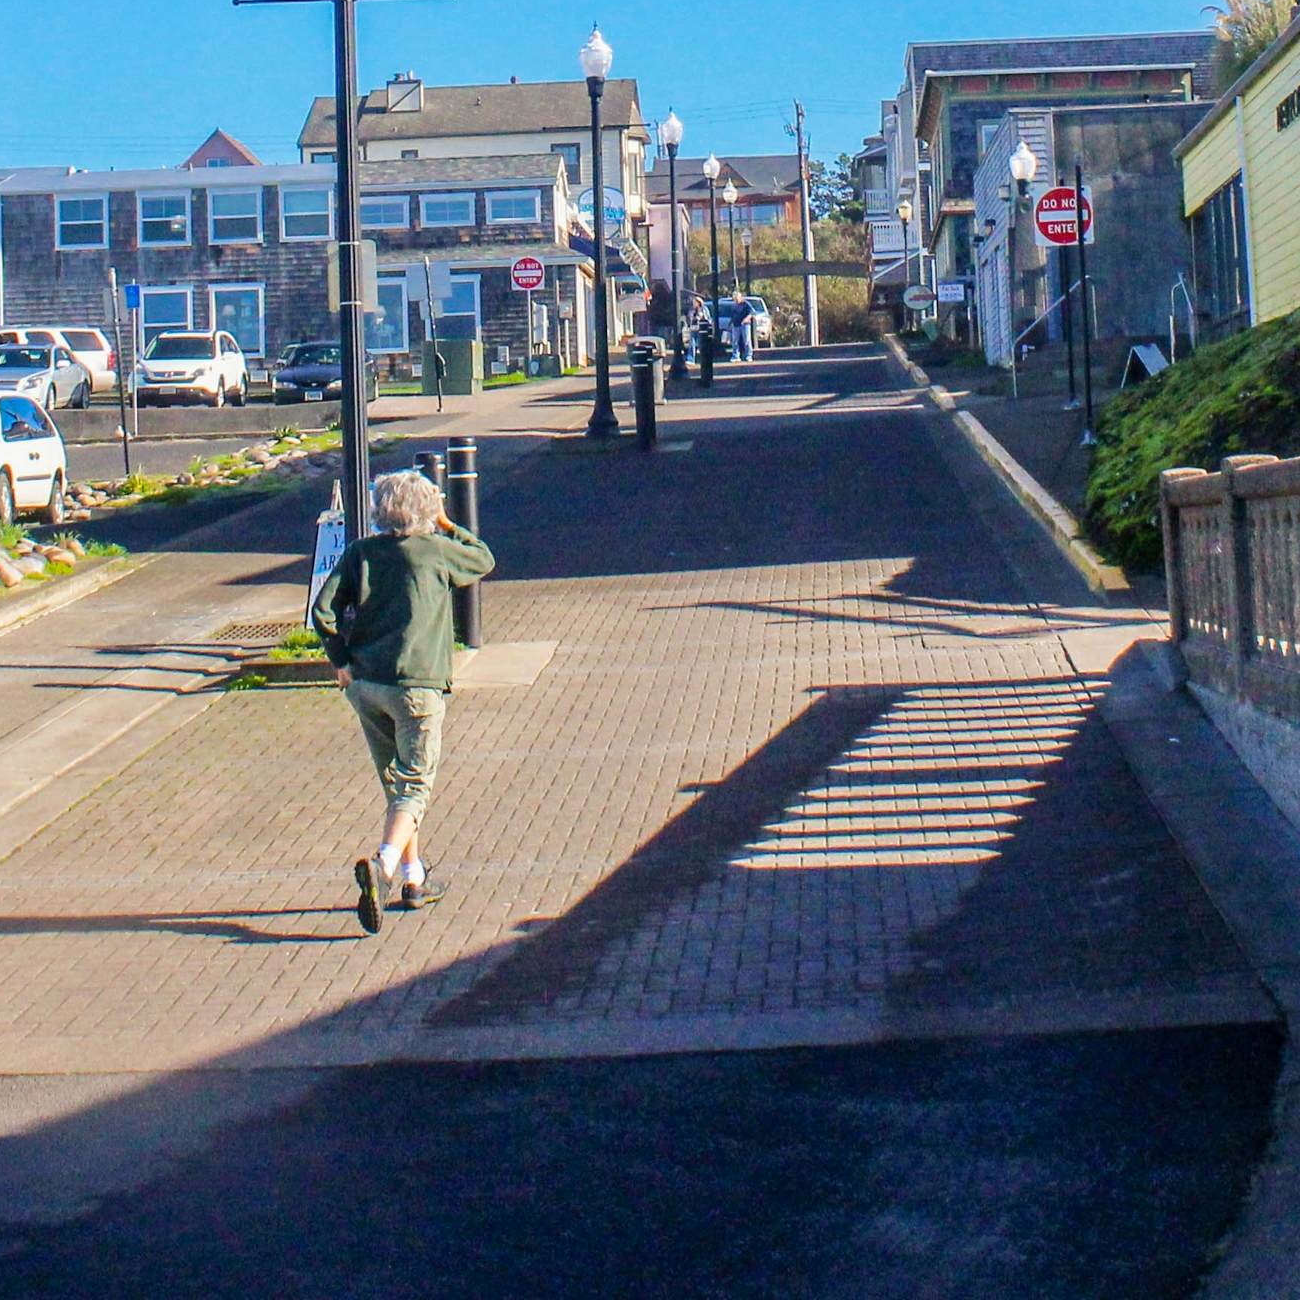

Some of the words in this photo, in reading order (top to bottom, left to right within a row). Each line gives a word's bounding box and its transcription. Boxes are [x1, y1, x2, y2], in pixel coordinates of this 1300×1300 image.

[1042, 198, 1058, 209] DO
[1061, 198, 1078, 208] NO
[1047, 222, 1077, 234] ENTE
